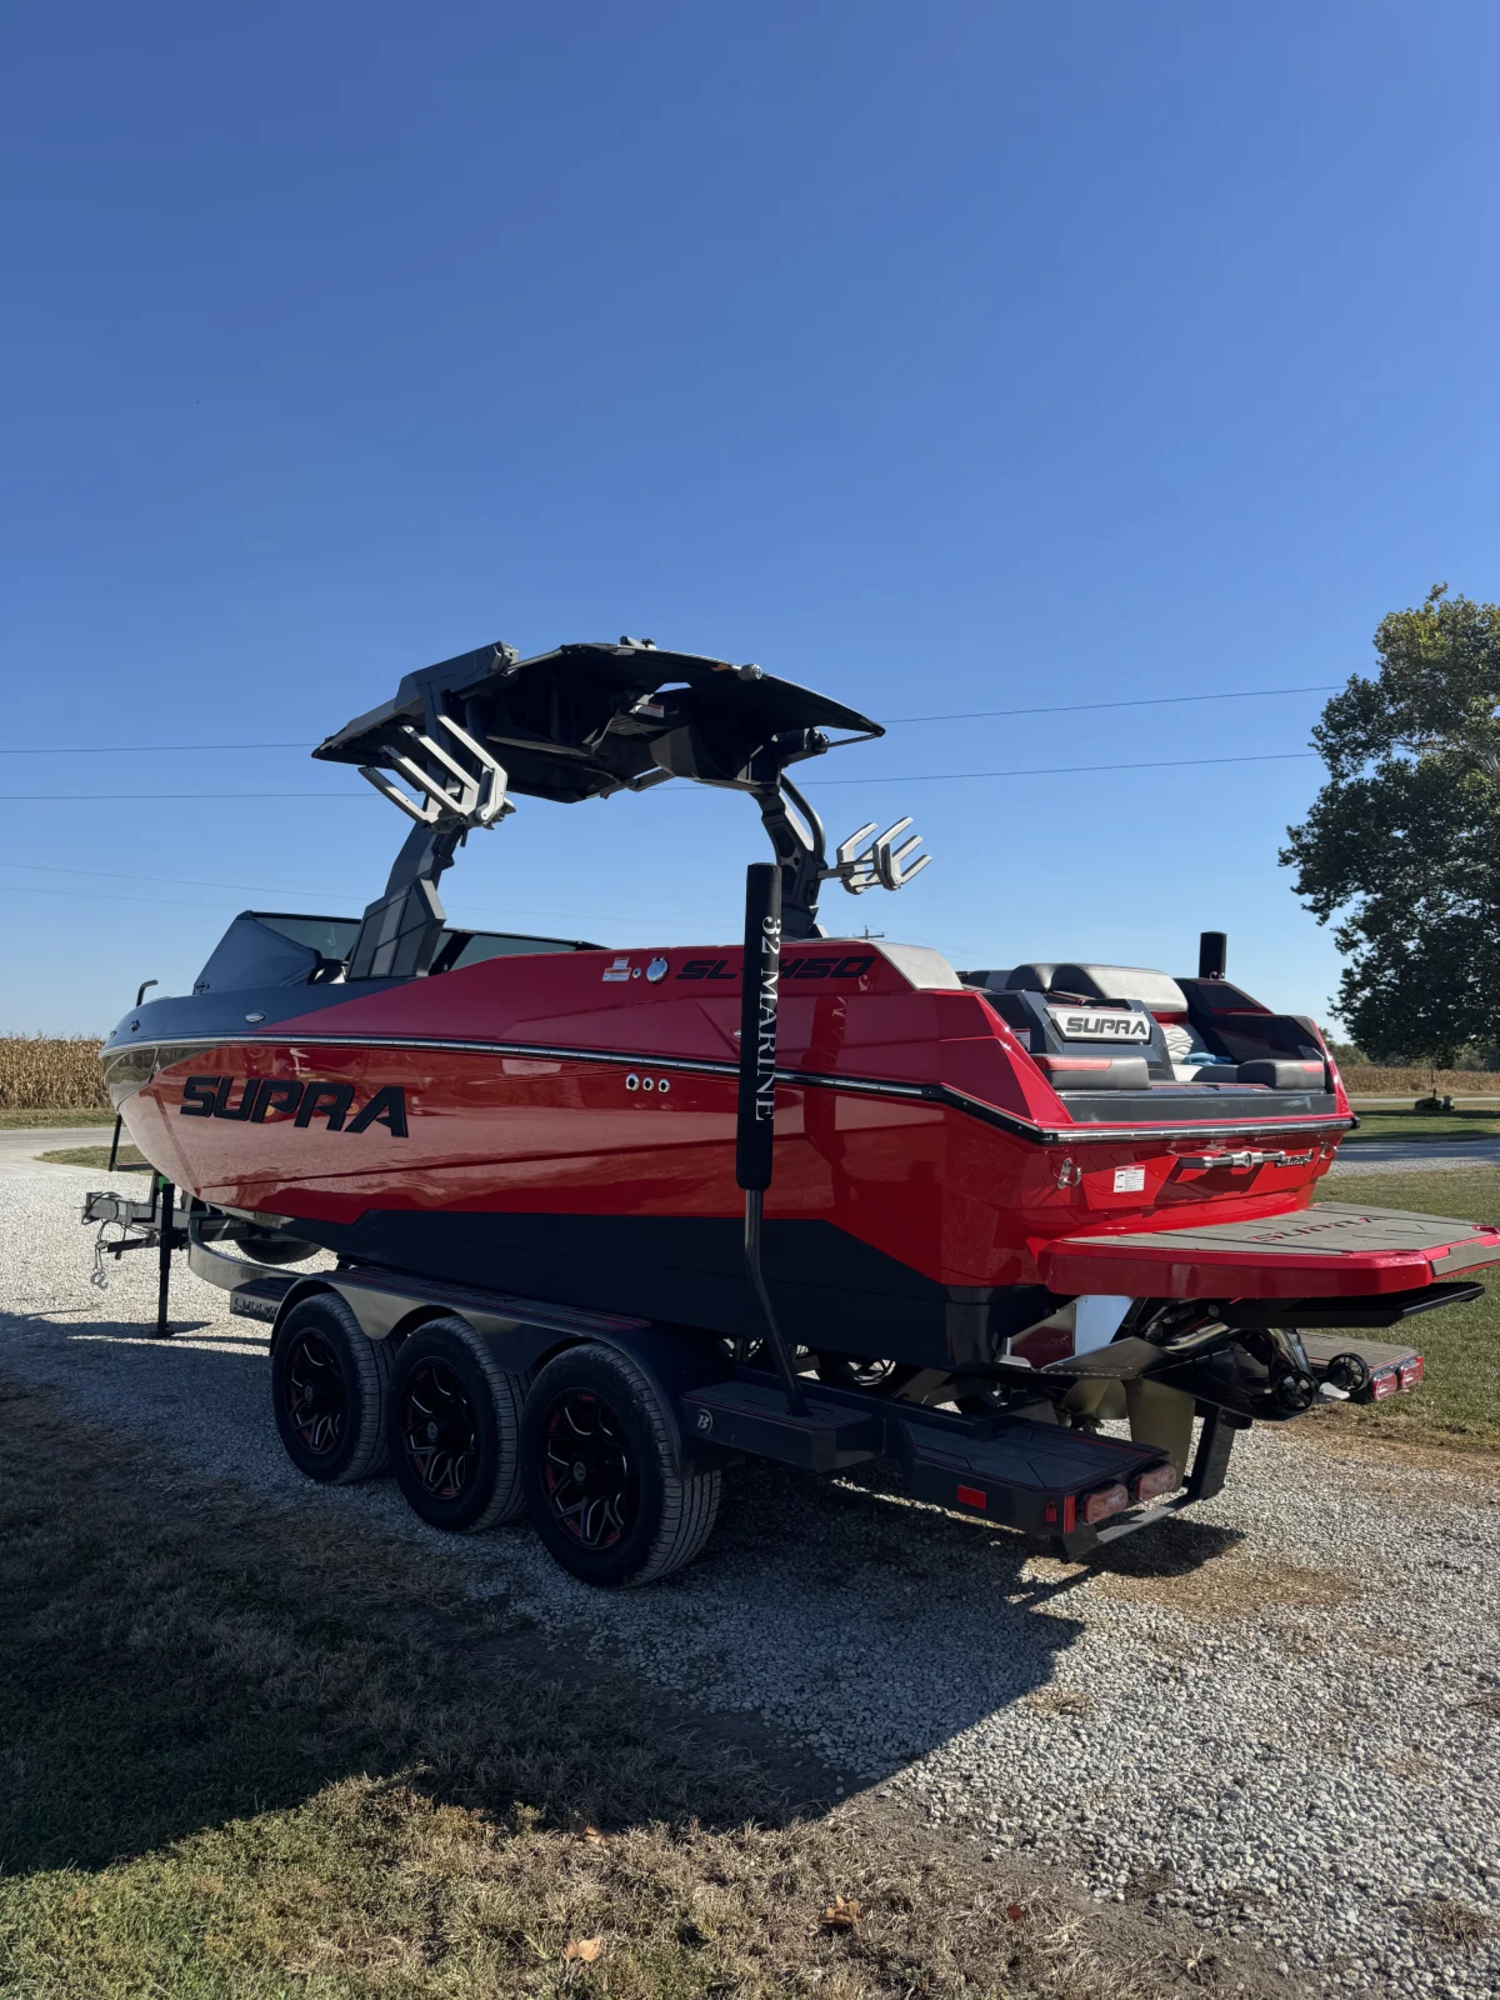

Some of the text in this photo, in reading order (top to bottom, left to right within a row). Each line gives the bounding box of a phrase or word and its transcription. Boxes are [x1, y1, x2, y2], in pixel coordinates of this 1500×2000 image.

[755, 916, 782, 1121] 32 MARINE
[1065, 1017, 1147, 1036] SUPRA
[179, 1075, 409, 1138] SUPRA
